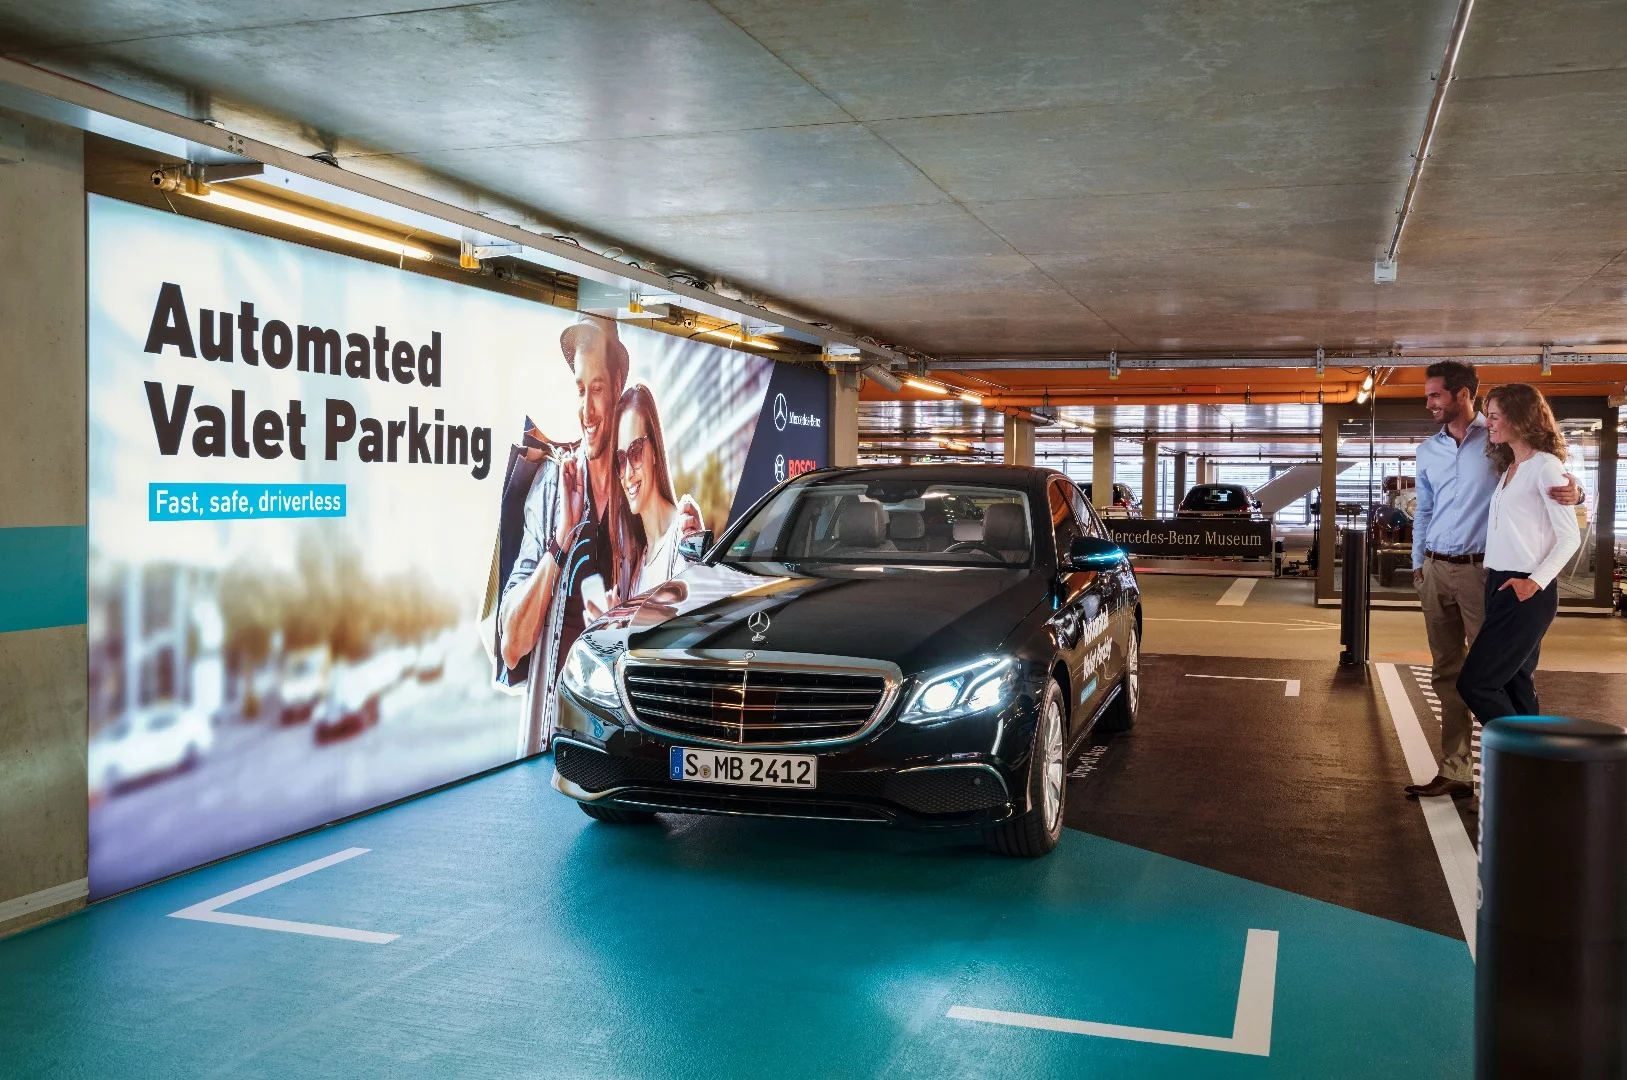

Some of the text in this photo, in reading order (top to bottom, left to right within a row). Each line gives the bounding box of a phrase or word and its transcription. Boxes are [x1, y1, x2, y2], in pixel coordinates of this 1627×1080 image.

[144, 282, 442, 387] Automated
[144, 380, 492, 480] Valet Parking
[156, 489, 341, 516] Fast, safe, driverless
[1205, 531, 1262, 546] Museum
[685, 753, 811, 785] S MB 2412
